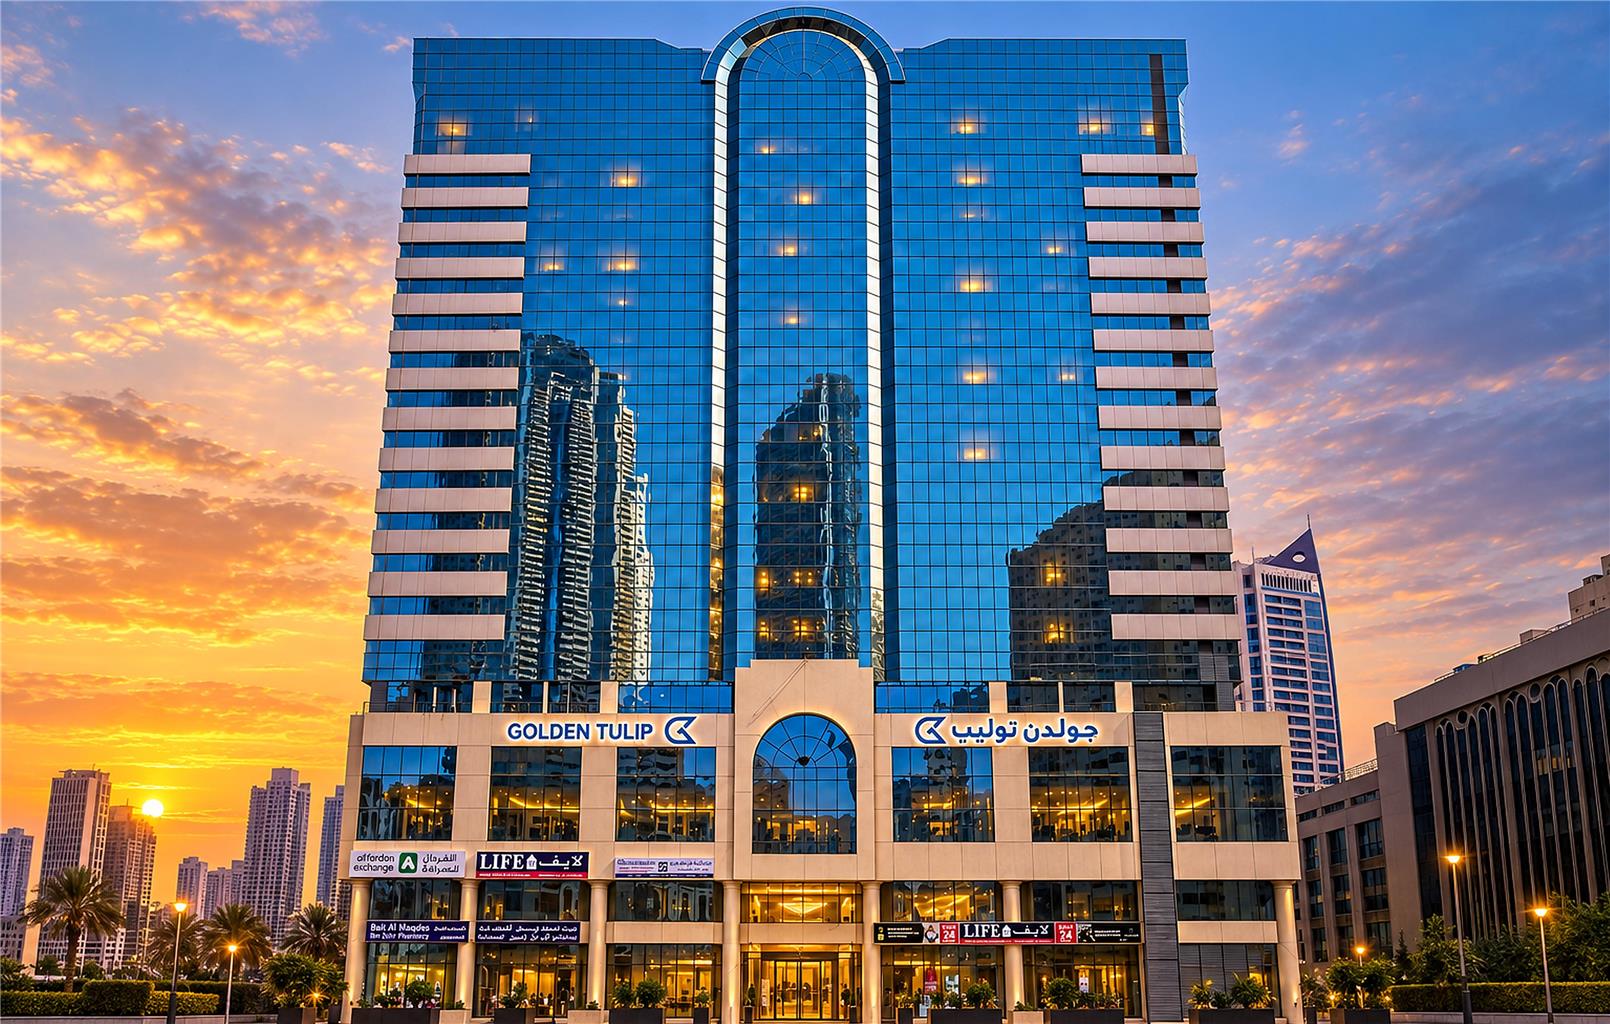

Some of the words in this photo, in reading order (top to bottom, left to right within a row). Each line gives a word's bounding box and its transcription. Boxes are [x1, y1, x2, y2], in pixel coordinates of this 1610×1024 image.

[507, 723, 590, 740] GOLDEN
[596, 723, 654, 740] TULIP
[1023, 718, 1099, 743] جولدن
[479, 853, 525, 870] LIFE
[538, 854, 584, 870] لايف
[943, 930, 955, 940] 24
[963, 923, 1001, 938] LIFE
[1012, 924, 1049, 938] لايف
[1059, 930, 1073, 939] 24
